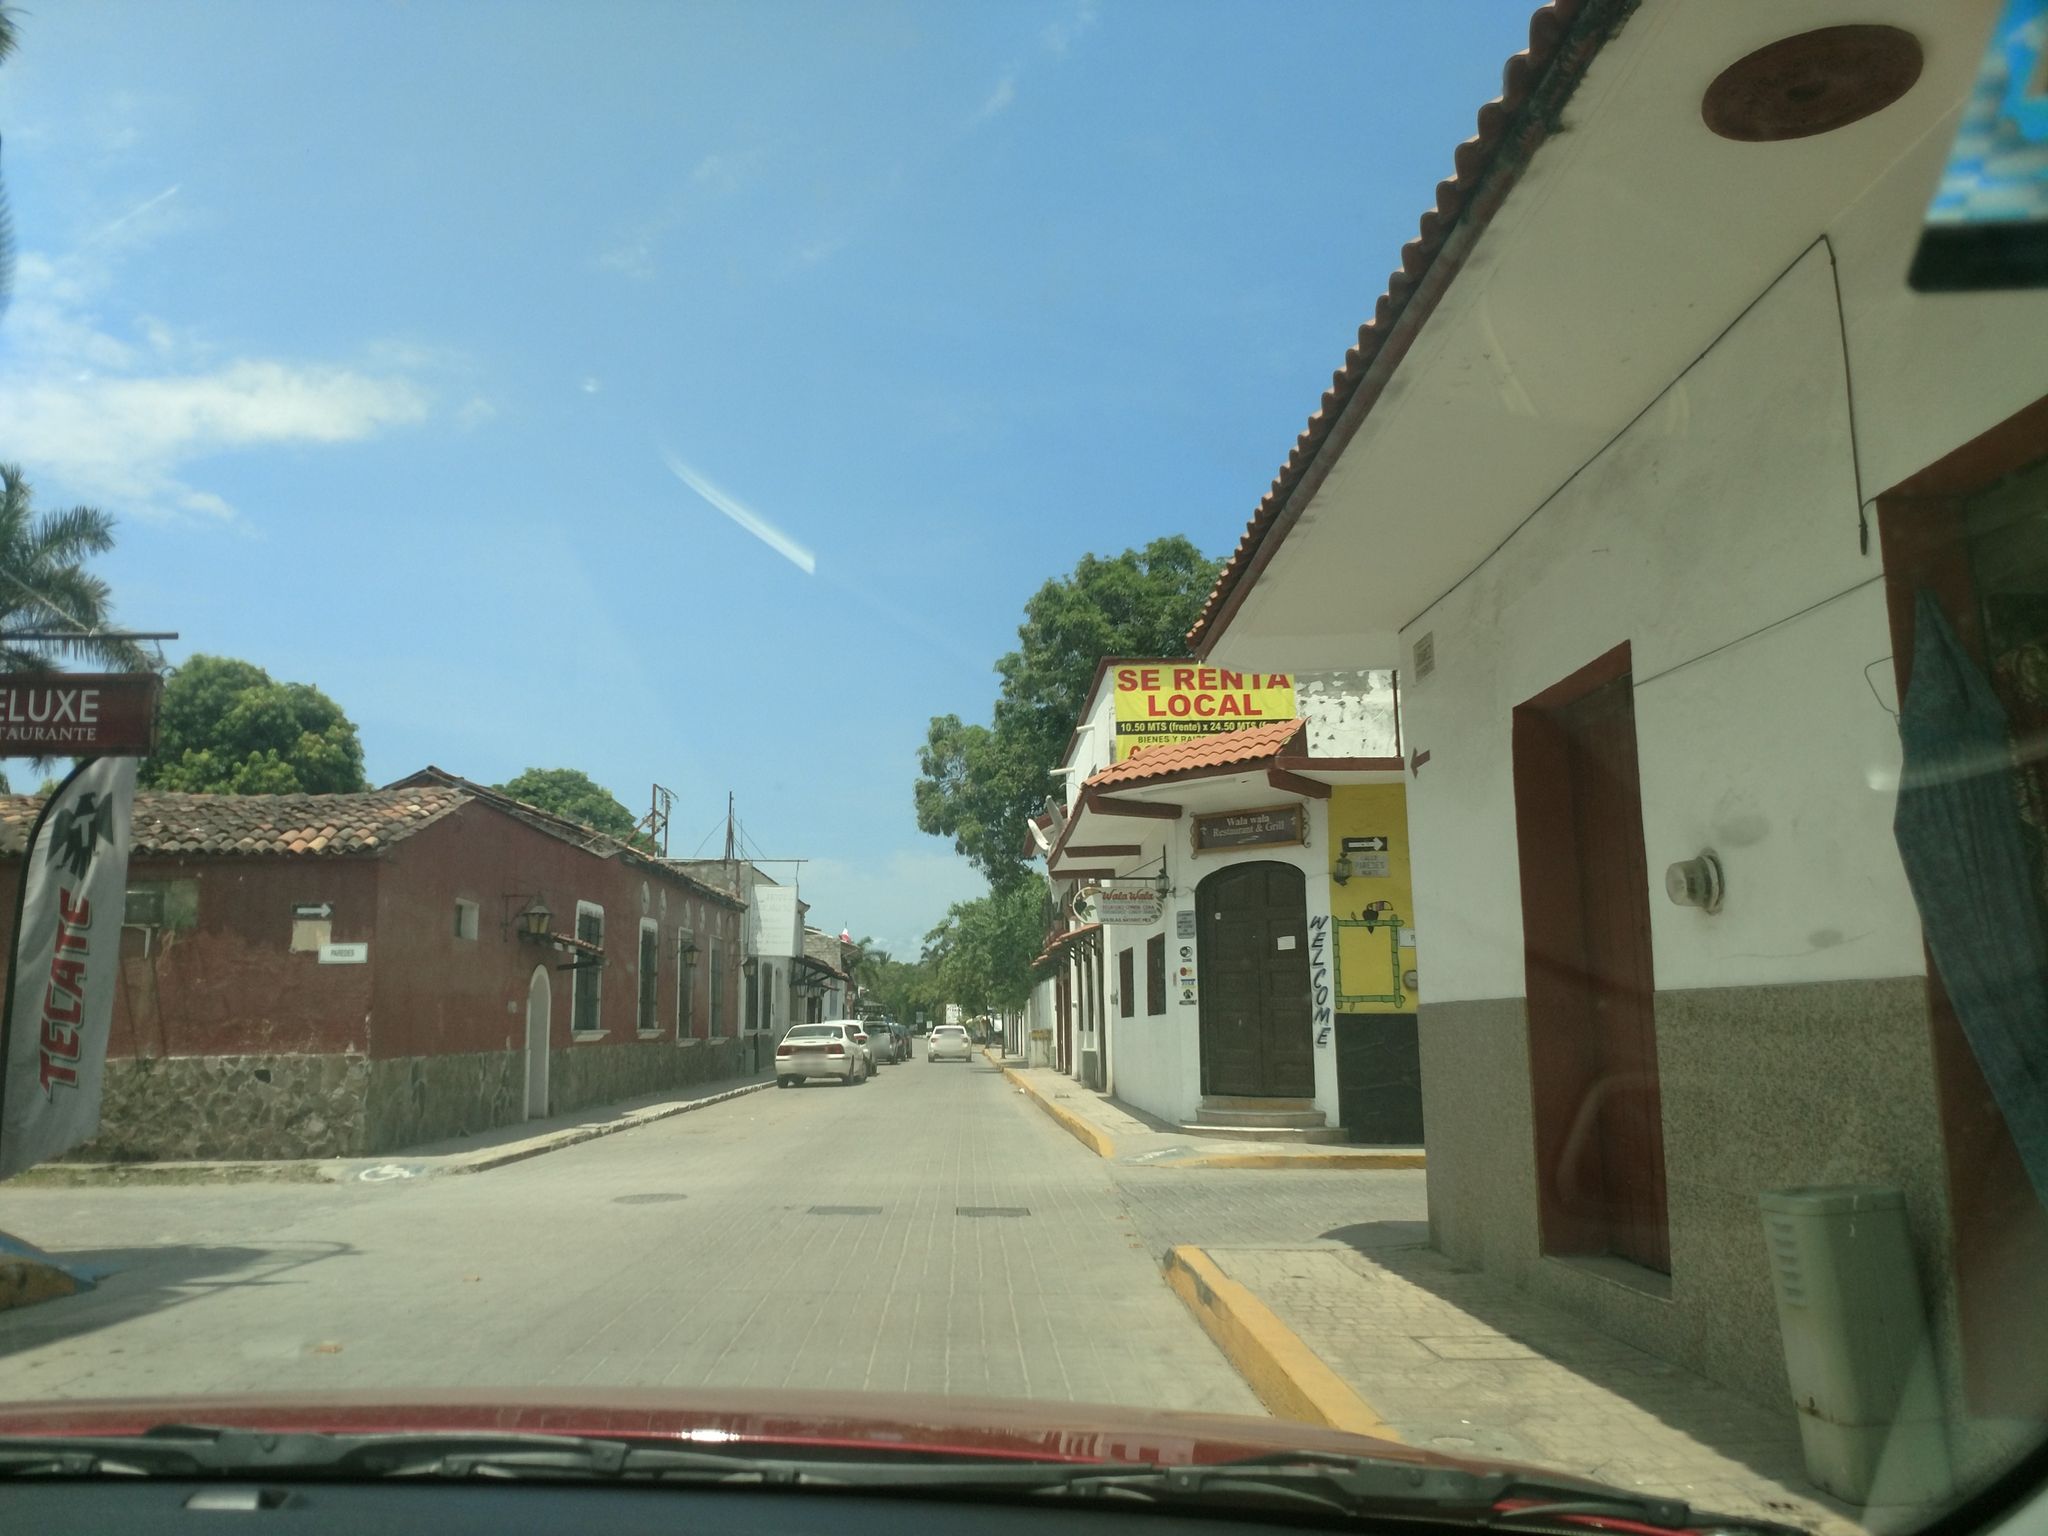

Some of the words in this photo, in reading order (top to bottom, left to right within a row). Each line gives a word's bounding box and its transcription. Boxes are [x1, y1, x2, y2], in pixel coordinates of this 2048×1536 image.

[1117, 669, 1160, 691] SE
[1174, 668, 1291, 691] RENTA
[1147, 694, 1263, 717] LOCAL
[1121, 722, 1145, 732] 10.50
[1147, 722, 1167, 731] MTS
[1169, 722, 1201, 733] (frente)
[1210, 722, 1235, 731] 24.50
[1137, 736, 1170, 744] BIENES
[1226, 816, 1248, 826] Wala
[1255, 823, 1263, 833] &
[1265, 820, 1285, 832] Grill
[1102, 888, 1128, 900] Wala
[1129, 888, 1154, 900] Wala
[1309, 914, 1332, 1047] WELCOME
[39, 886, 92, 1097] TECATE
